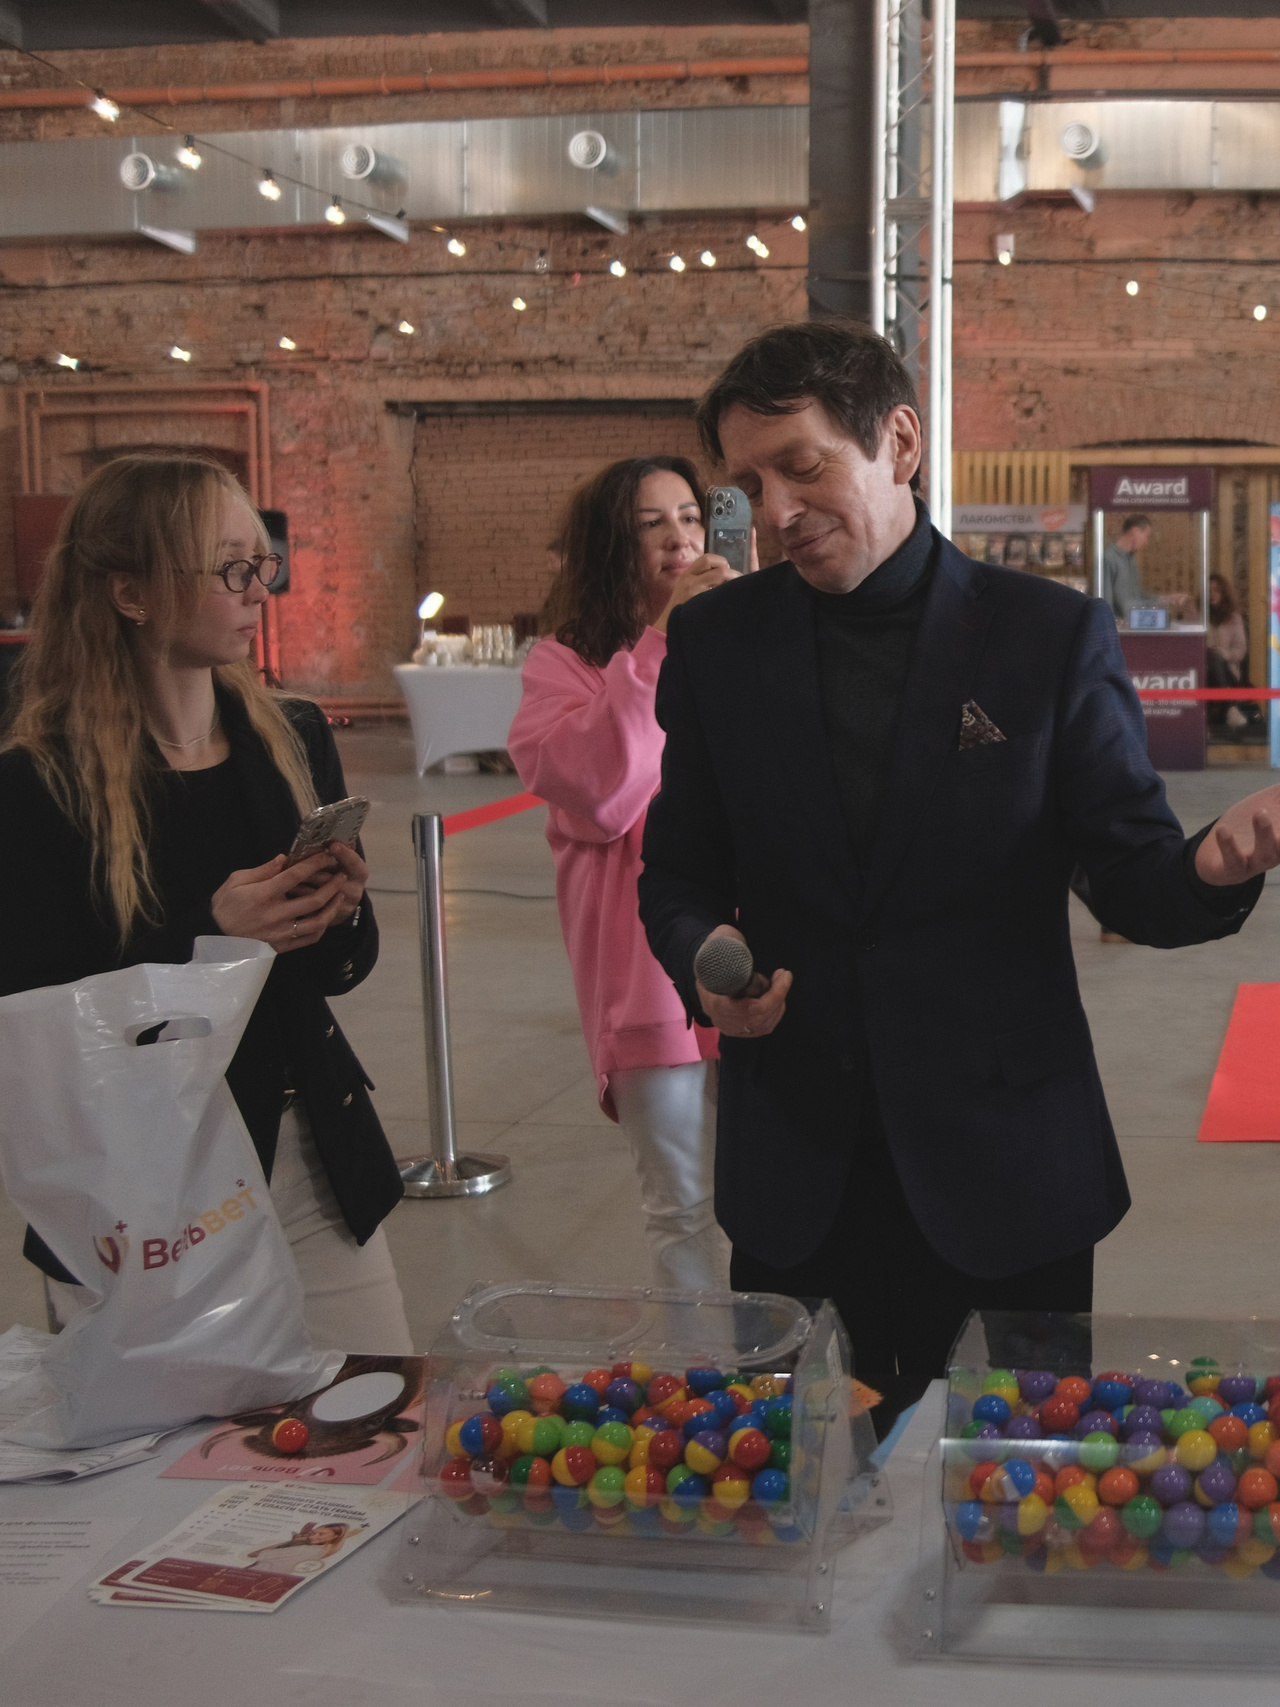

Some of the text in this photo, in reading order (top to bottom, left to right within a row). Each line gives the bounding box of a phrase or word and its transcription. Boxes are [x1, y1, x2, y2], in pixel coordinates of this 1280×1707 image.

[1116, 478, 1187, 496] Award
[959, 514, 1034, 525] ЛАКОМСТВА
[1132, 669, 1196, 689] ward
[261, 1503, 298, 1512] СПАСТИ
[303, 1503, 330, 1512] СТАТЬ
[330, 1507, 367, 1517] ГЕРОЕМ
